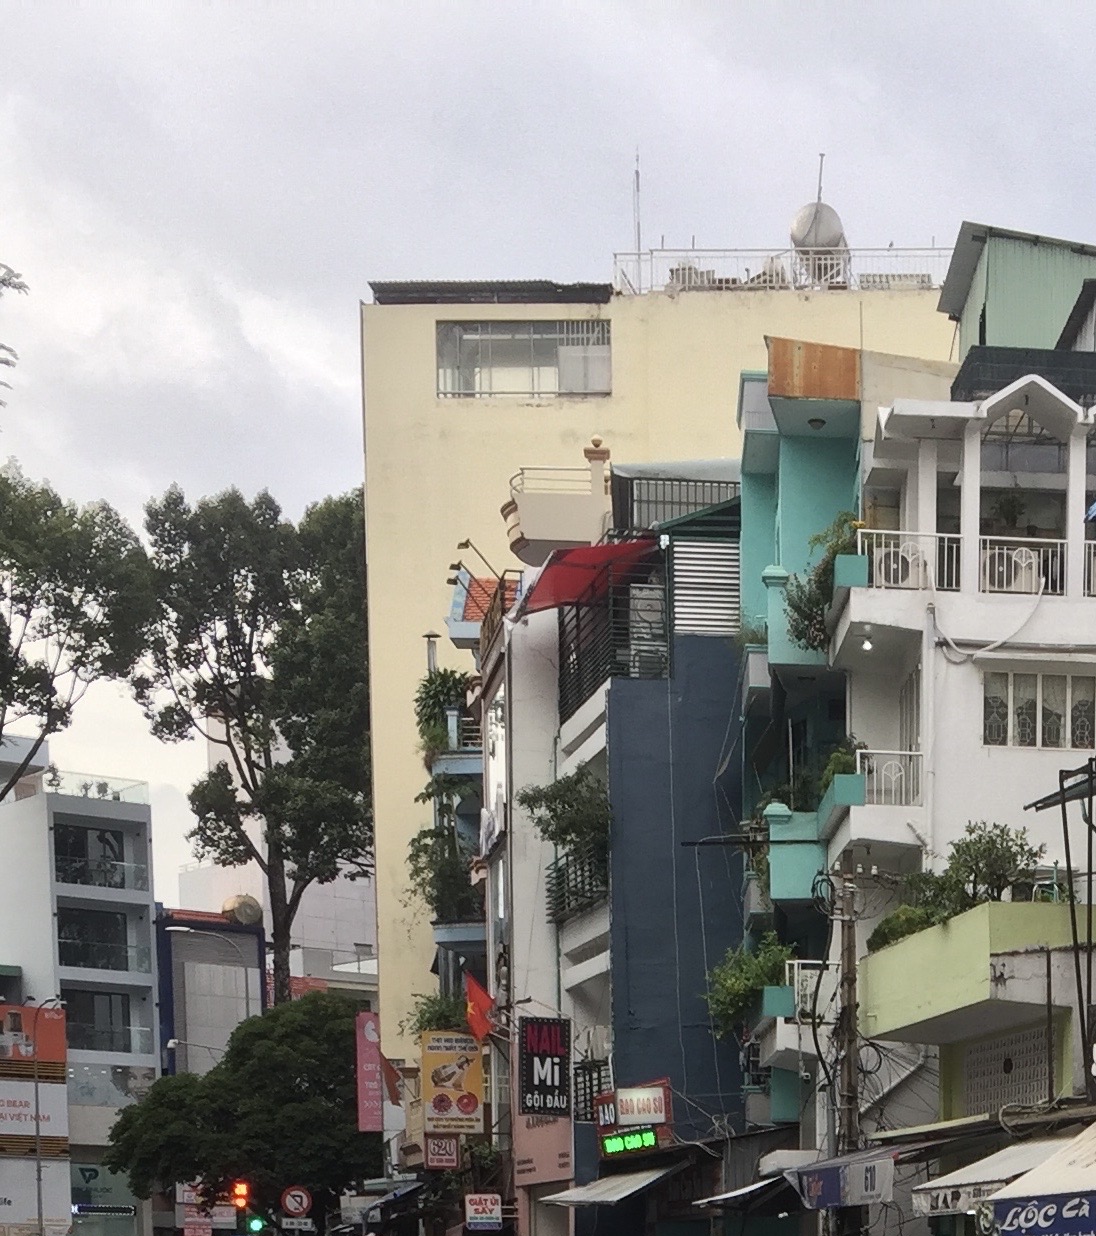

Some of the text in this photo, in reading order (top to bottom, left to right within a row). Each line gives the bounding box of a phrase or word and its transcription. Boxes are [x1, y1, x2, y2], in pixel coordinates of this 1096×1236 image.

[526, 1024, 566, 1056] NAIL
[533, 1057, 560, 1087] Mi
[1000, 1200, 1057, 1234] LỘC
[1062, 1197, 1089, 1219] Cà
